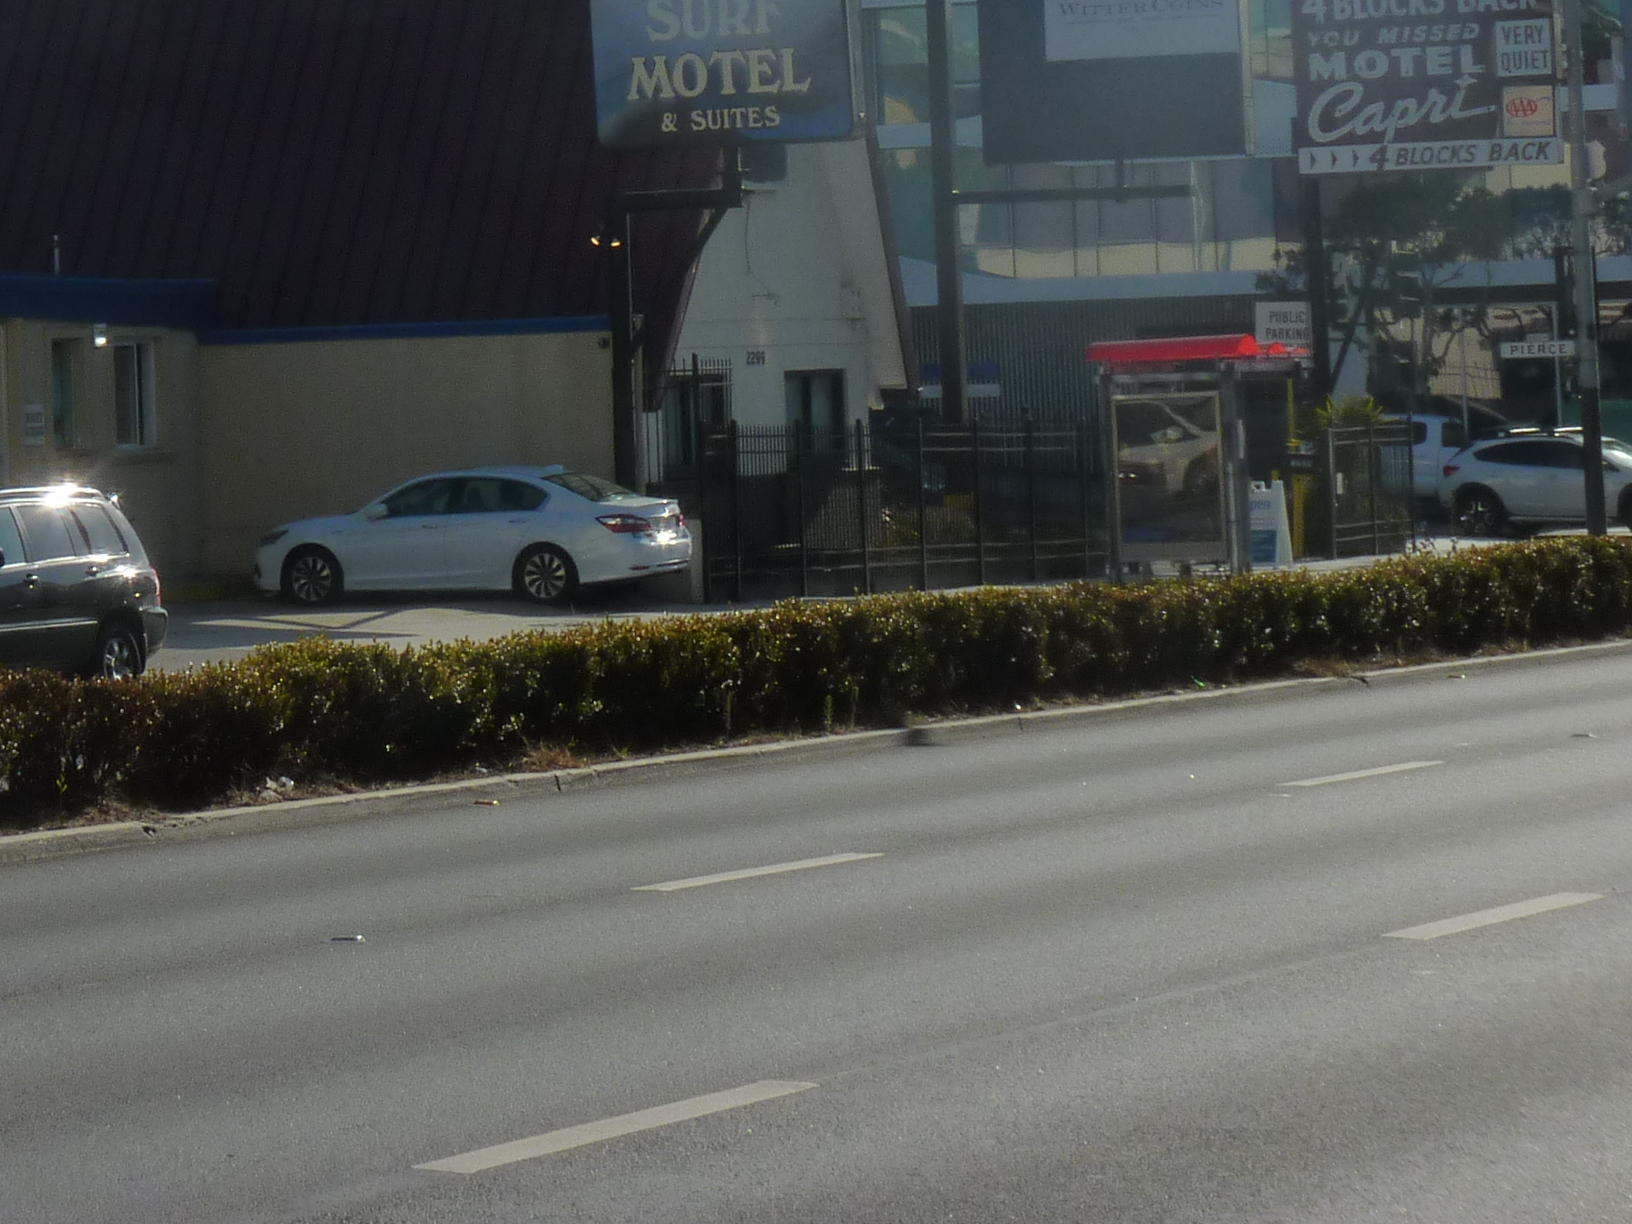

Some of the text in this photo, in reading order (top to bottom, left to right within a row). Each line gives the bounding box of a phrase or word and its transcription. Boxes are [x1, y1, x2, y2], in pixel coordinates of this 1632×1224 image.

[1307, 23, 1480, 47] YOU MISSED
[1500, 25, 1544, 46] VERY
[1309, 44, 1485, 82] MOTEL
[1500, 49, 1548, 72] QUIET
[627, 47, 811, 101] MOTEL
[661, 105, 781, 132] & SUITES
[1308, 73, 1496, 145] Capri
[1369, 141, 1551, 170] 4 BLOCKS BACK
[1269, 311, 1306, 324] PUBLIC
[1510, 344, 1567, 355] PIERCE
